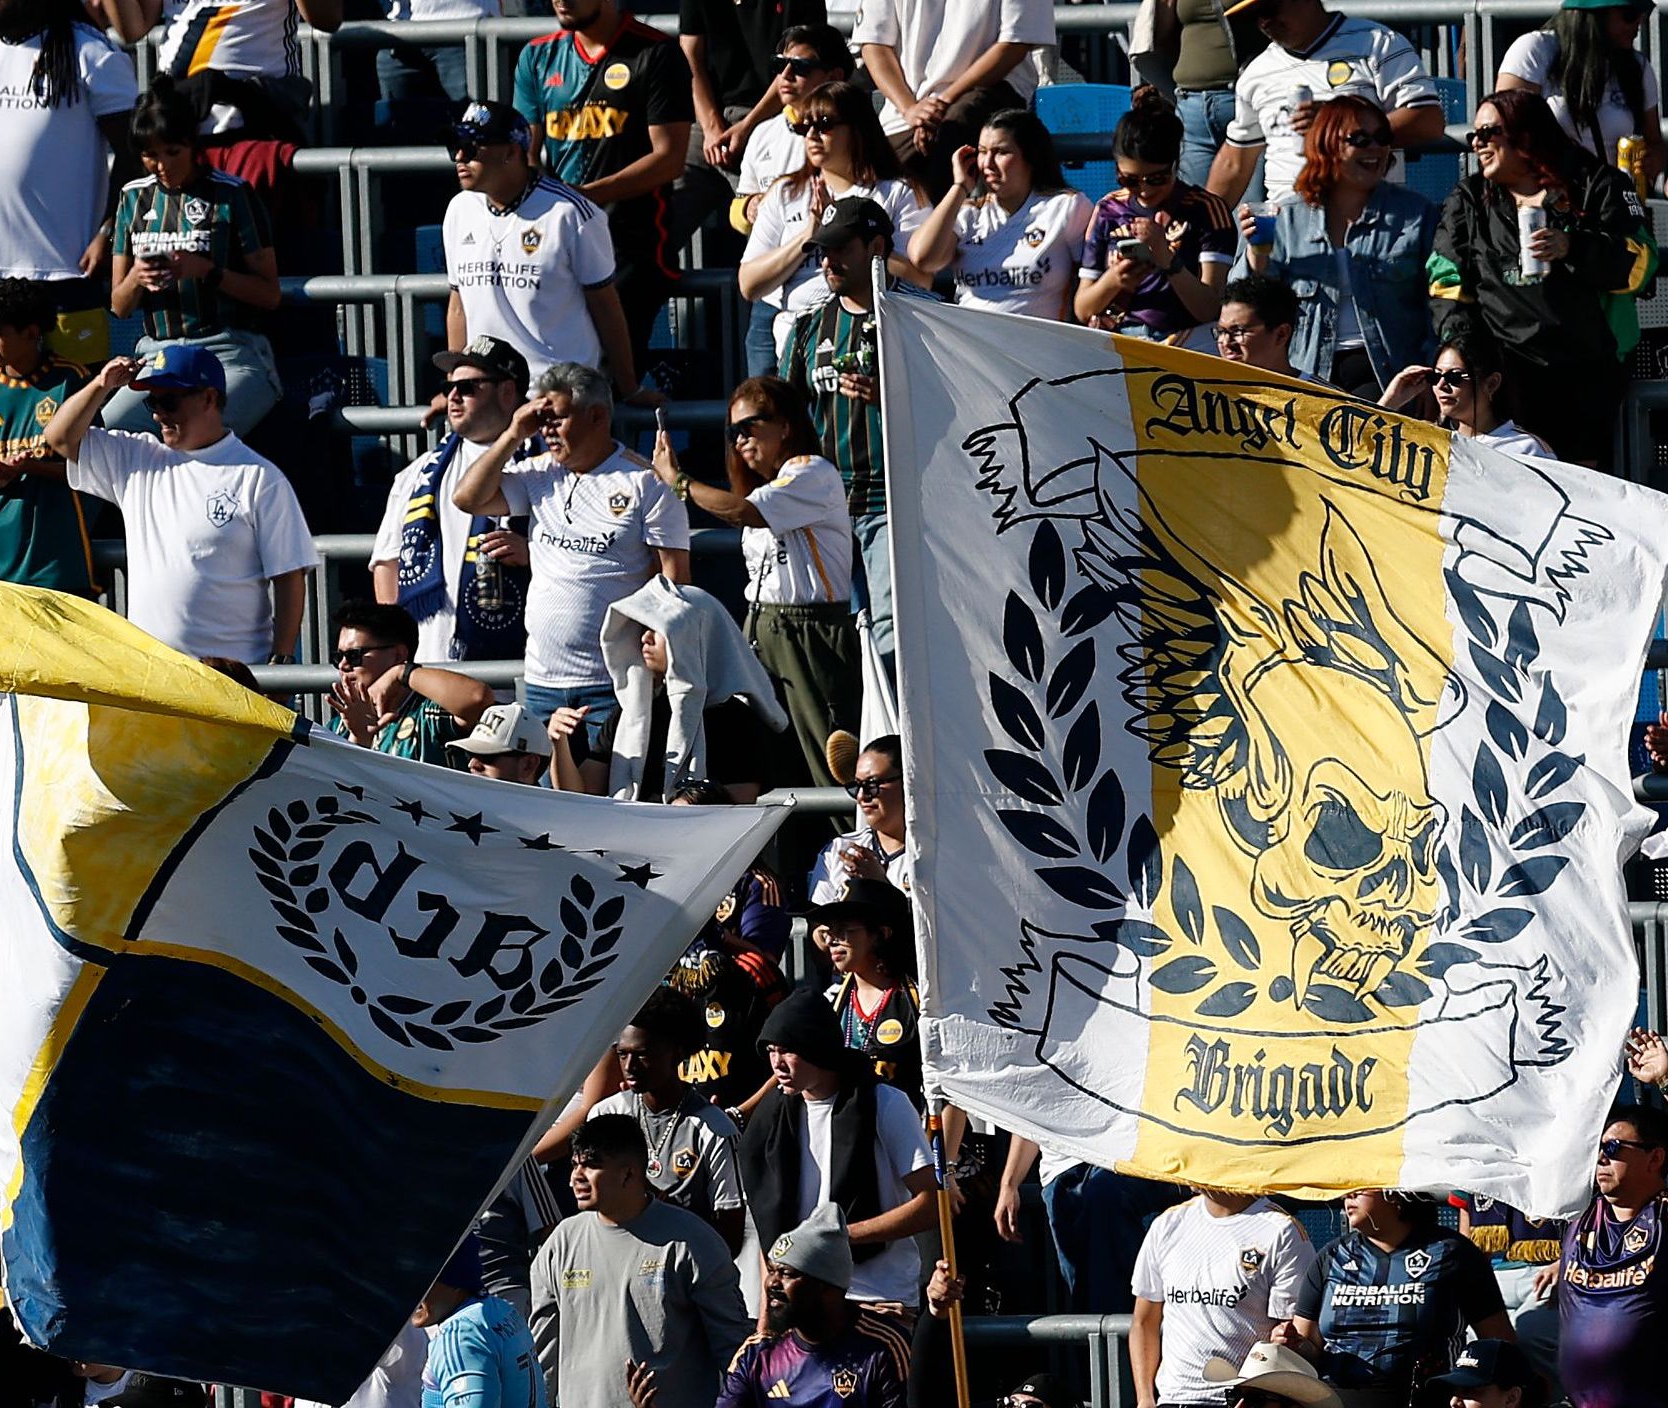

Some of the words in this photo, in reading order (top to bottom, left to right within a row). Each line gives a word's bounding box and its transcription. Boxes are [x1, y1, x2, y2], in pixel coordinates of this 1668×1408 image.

[545, 106, 629, 140] GALAXY
[457, 262, 540, 277] HERBALIFE
[457, 275, 540, 291] NUTRITION
[1146, 372, 1300, 450] Angel
[1319, 393, 1436, 499] City
[1179, 1034, 1376, 1138] Brigade
[1166, 1284, 1239, 1310] Herbalife
[1332, 1283, 1425, 1297] HERBALIFE
[1330, 1294, 1425, 1308] NUTRITION
